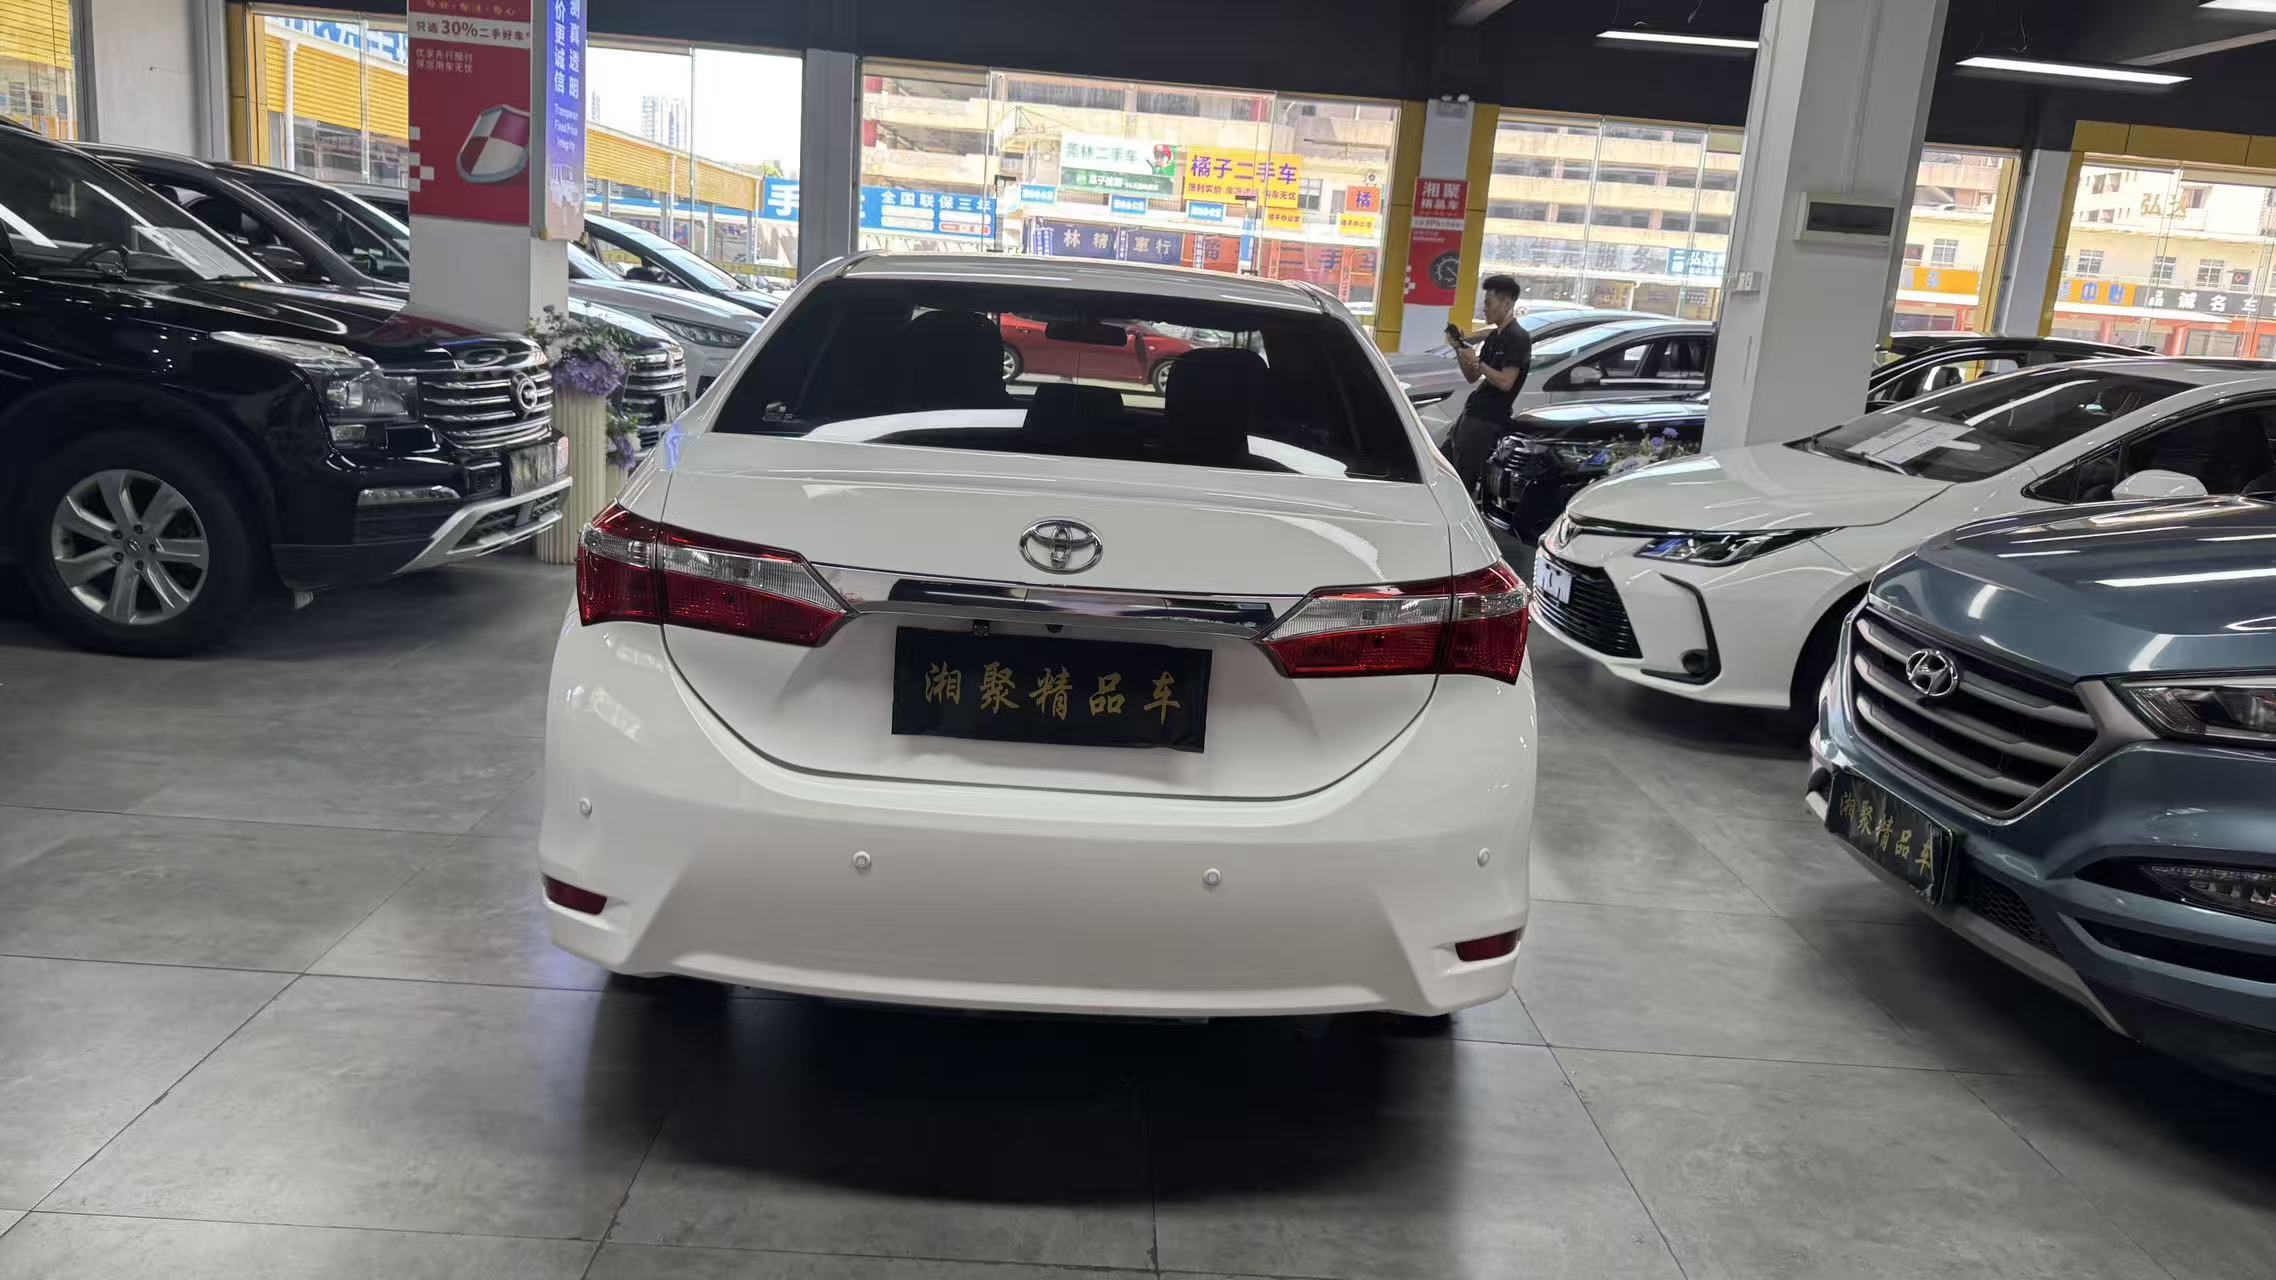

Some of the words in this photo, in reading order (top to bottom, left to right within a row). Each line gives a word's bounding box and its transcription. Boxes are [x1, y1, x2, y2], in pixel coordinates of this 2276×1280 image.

[1191, 154, 1297, 185] 橘子二手车
[881, 190, 991, 212] 全国联保三年
[1356, 191, 1372, 208] 橘
[1422, 181, 1460, 199] 湘聚
[925, 661, 1181, 726] 湘聚精品车
[1840, 792, 1931, 876] 湘聚精品车
